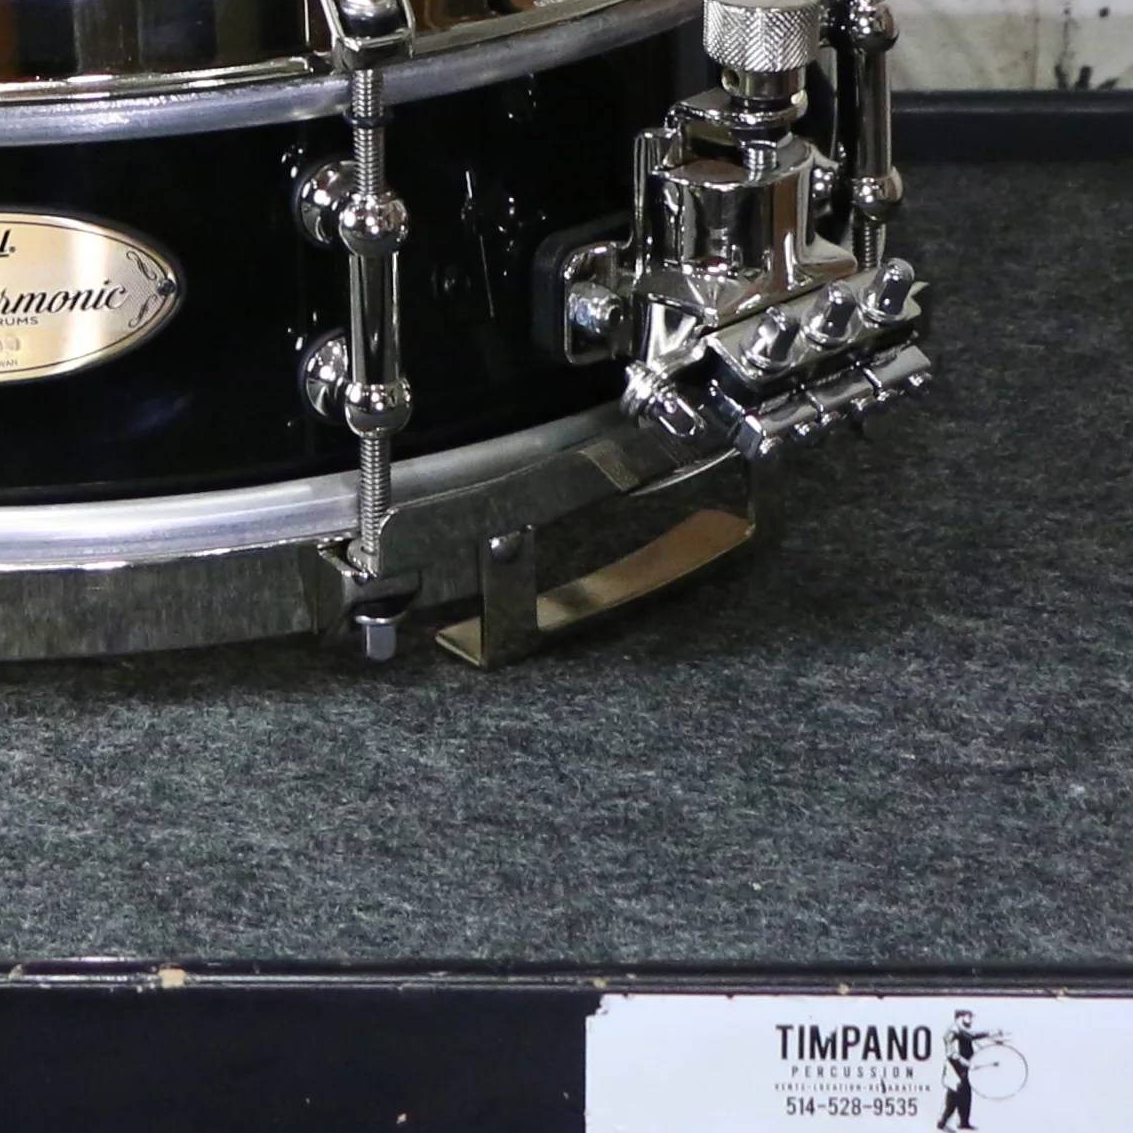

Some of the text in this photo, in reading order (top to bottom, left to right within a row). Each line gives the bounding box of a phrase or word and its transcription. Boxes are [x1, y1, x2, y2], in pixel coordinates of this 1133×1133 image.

[776, 1024, 932, 1061] TIMPANO
[791, 1066, 914, 1078] PERCUSSION
[786, 1096, 919, 1116] 514-528-9535
